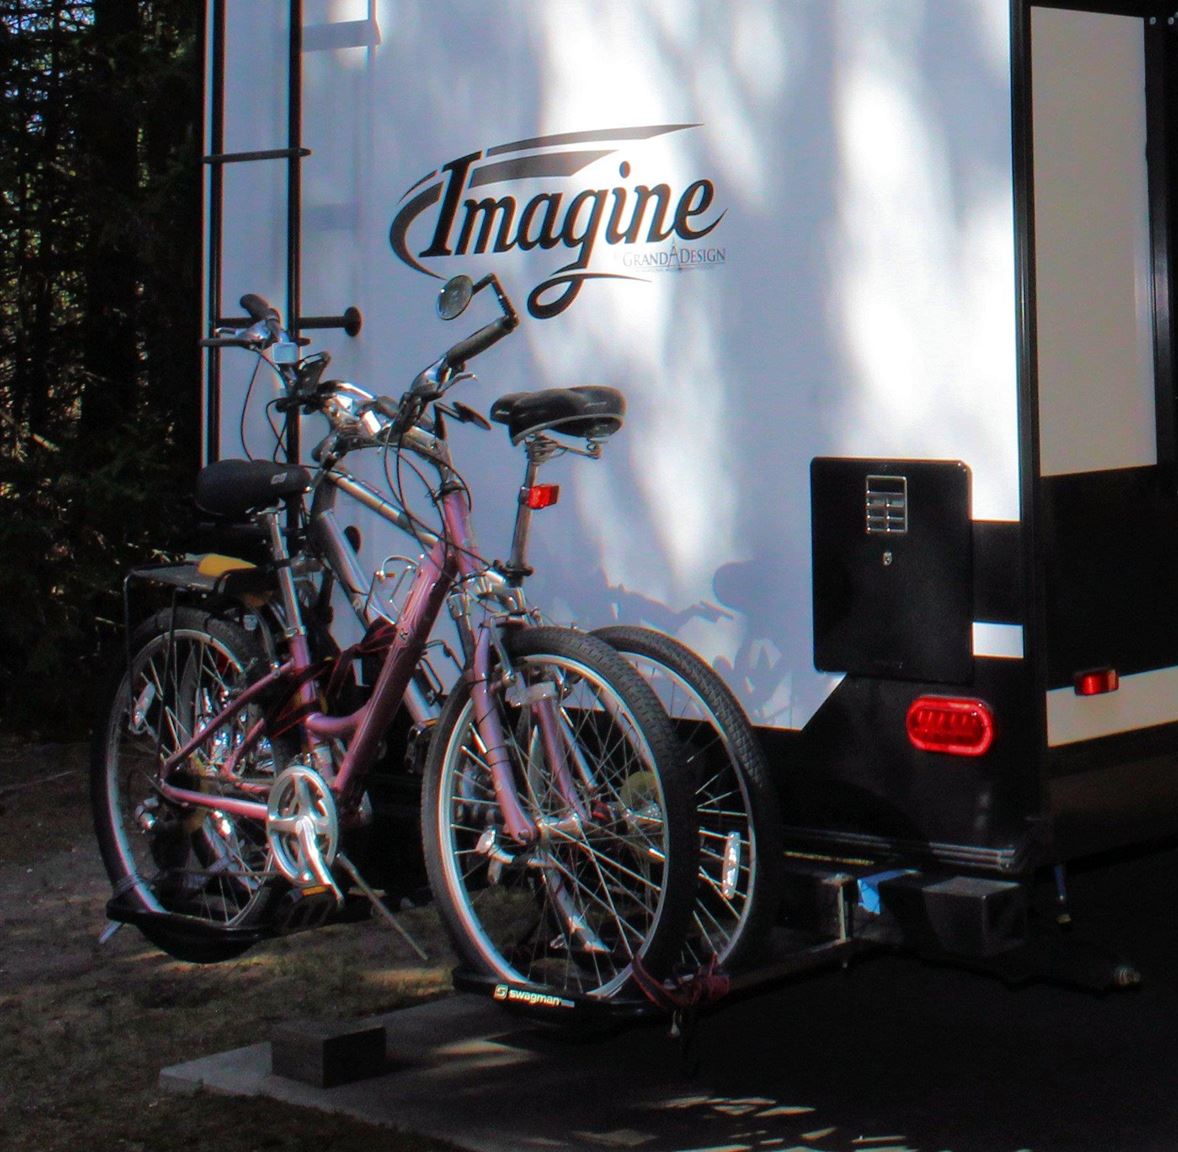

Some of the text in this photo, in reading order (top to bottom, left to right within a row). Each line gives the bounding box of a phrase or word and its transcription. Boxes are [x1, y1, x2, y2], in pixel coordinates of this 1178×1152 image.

[418, 150, 728, 320] Imagine
[680, 247, 726, 264] DESIGN
[509, 989, 562, 1006] swagman
